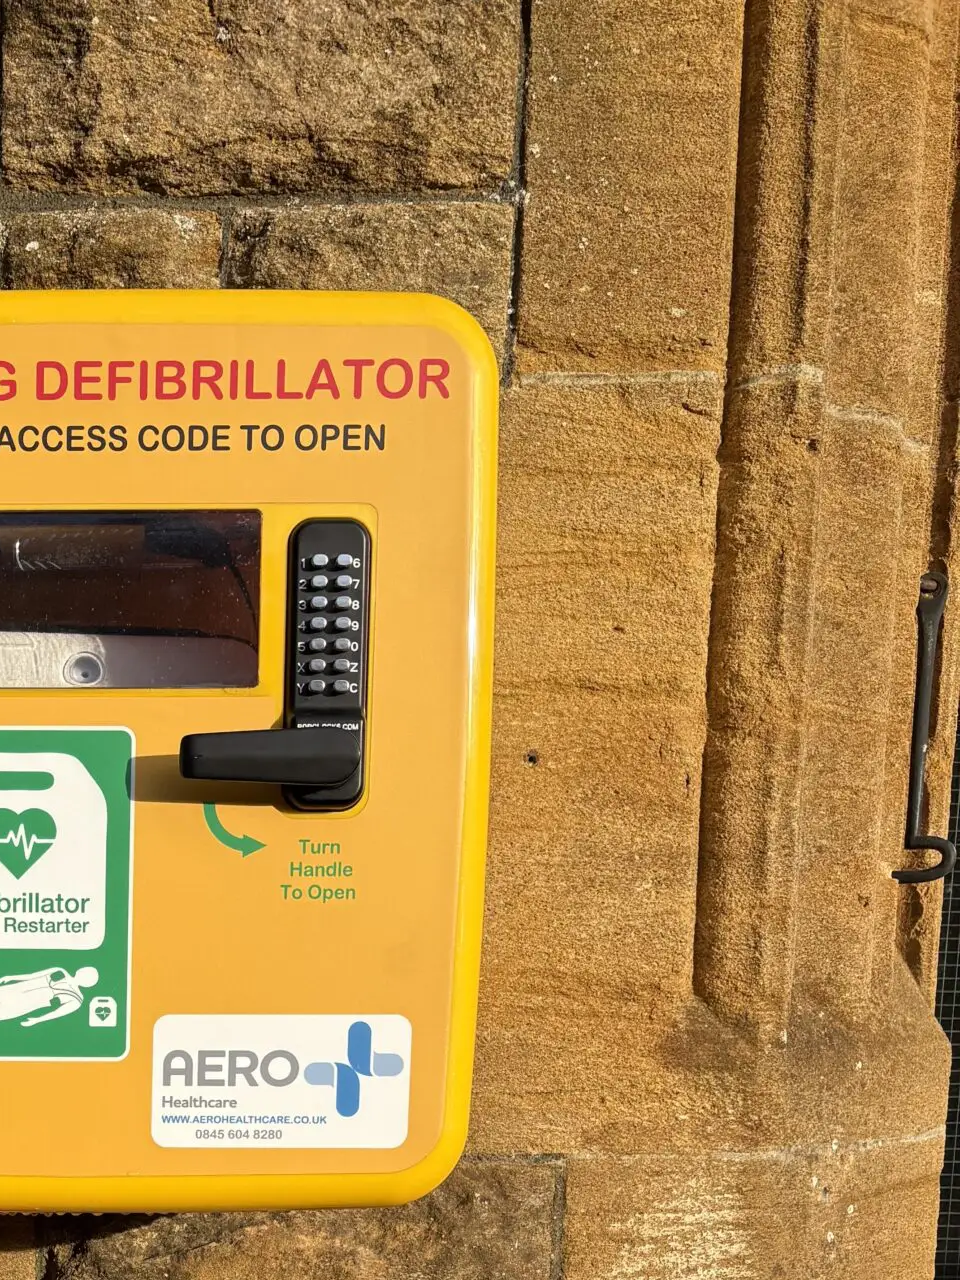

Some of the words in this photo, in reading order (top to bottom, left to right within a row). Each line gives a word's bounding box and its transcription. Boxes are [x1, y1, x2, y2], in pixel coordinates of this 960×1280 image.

[36, 358, 449, 400] DEFIBRILLATOR
[138, 425, 230, 451] CODE
[240, 425, 284, 451] TO
[295, 424, 385, 451] OPEN
[300, 558, 306, 568] 1
[351, 558, 361, 569] 6
[298, 579, 307, 590] 2
[351, 579, 361, 590] 7
[298, 600, 306, 610] 3
[350, 600, 360, 611] 8
[297, 621, 306, 633] 4
[350, 621, 360, 631] 9
[297, 642, 305, 653] 5
[349, 642, 359, 652] 0
[297, 663, 305, 673] X
[349, 663, 359, 673] Z
[296, 683, 305, 693] Y
[348, 683, 358, 694] C
[299, 839, 340, 854] Turn
[290, 862, 352, 877] Handle
[280, 885, 302, 899] To
[308, 885, 355, 903] Open
[4, 917, 89, 933] Restarter
[163, 1050, 299, 1087] AERO
[161, 1096, 238, 1109] Healthcare
[161, 1116, 327, 1125] WWW.AEROHEALTHCARE.CO.UK
[195, 1130, 225, 1140] 0845
[228, 1130, 249, 1139] 604
[252, 1130, 283, 1140] 8280
